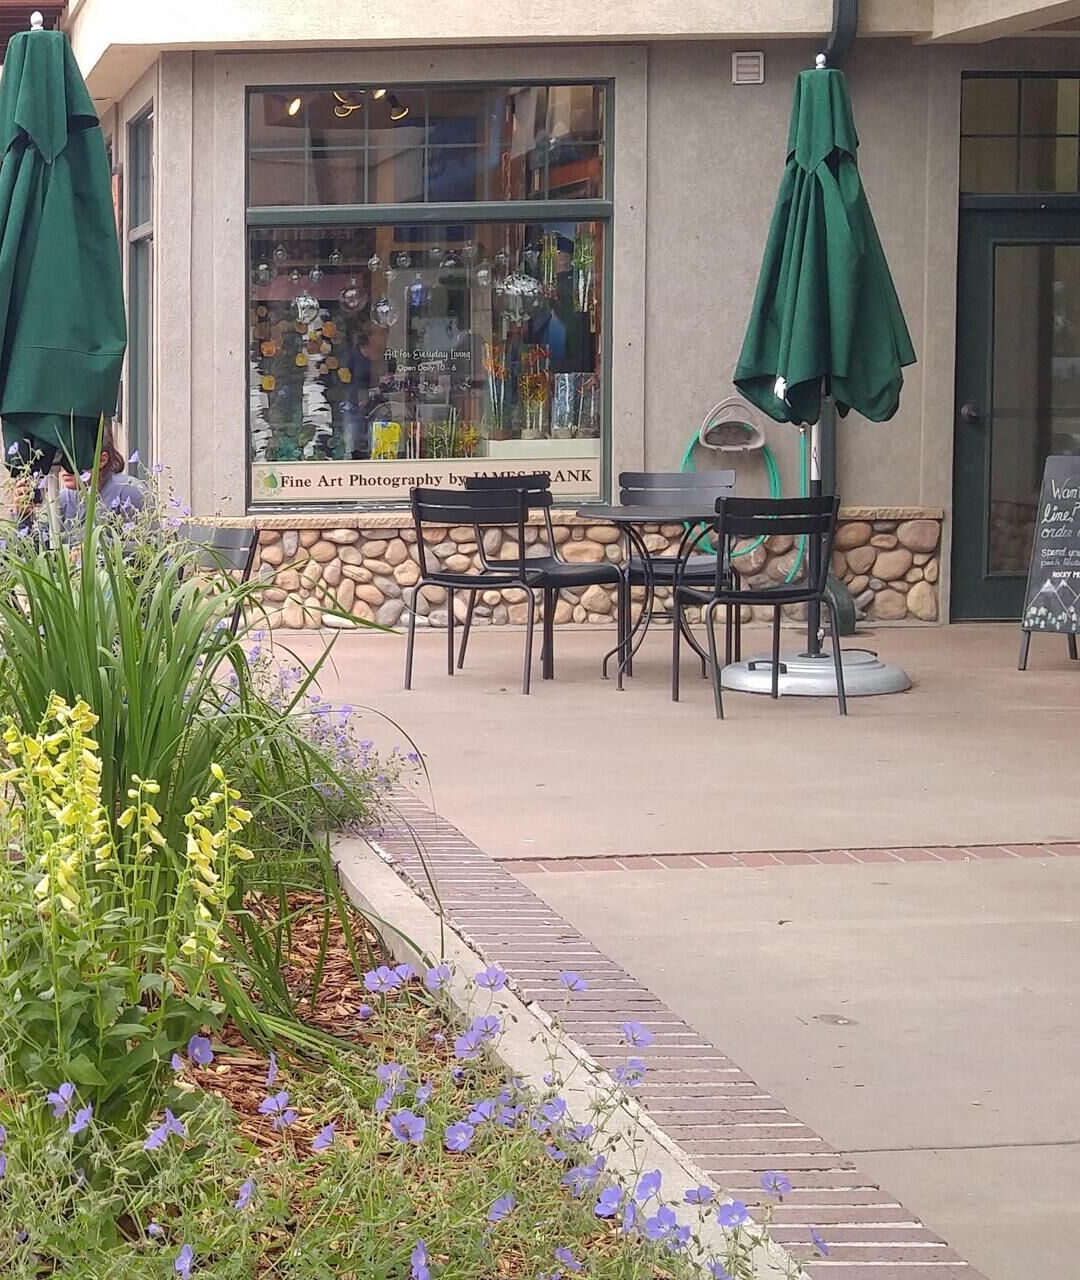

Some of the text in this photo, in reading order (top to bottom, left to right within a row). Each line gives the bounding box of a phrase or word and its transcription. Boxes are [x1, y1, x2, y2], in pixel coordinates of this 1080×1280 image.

[383, 349, 398, 361] Art
[412, 349, 448, 361] Everyday
[450, 348, 471, 361] Living
[397, 364, 416, 372] Open
[281, 476, 312, 488] Fine
[319, 474, 343, 487] Art
[349, 473, 443, 488] Photography
[449, 472, 466, 487] by
